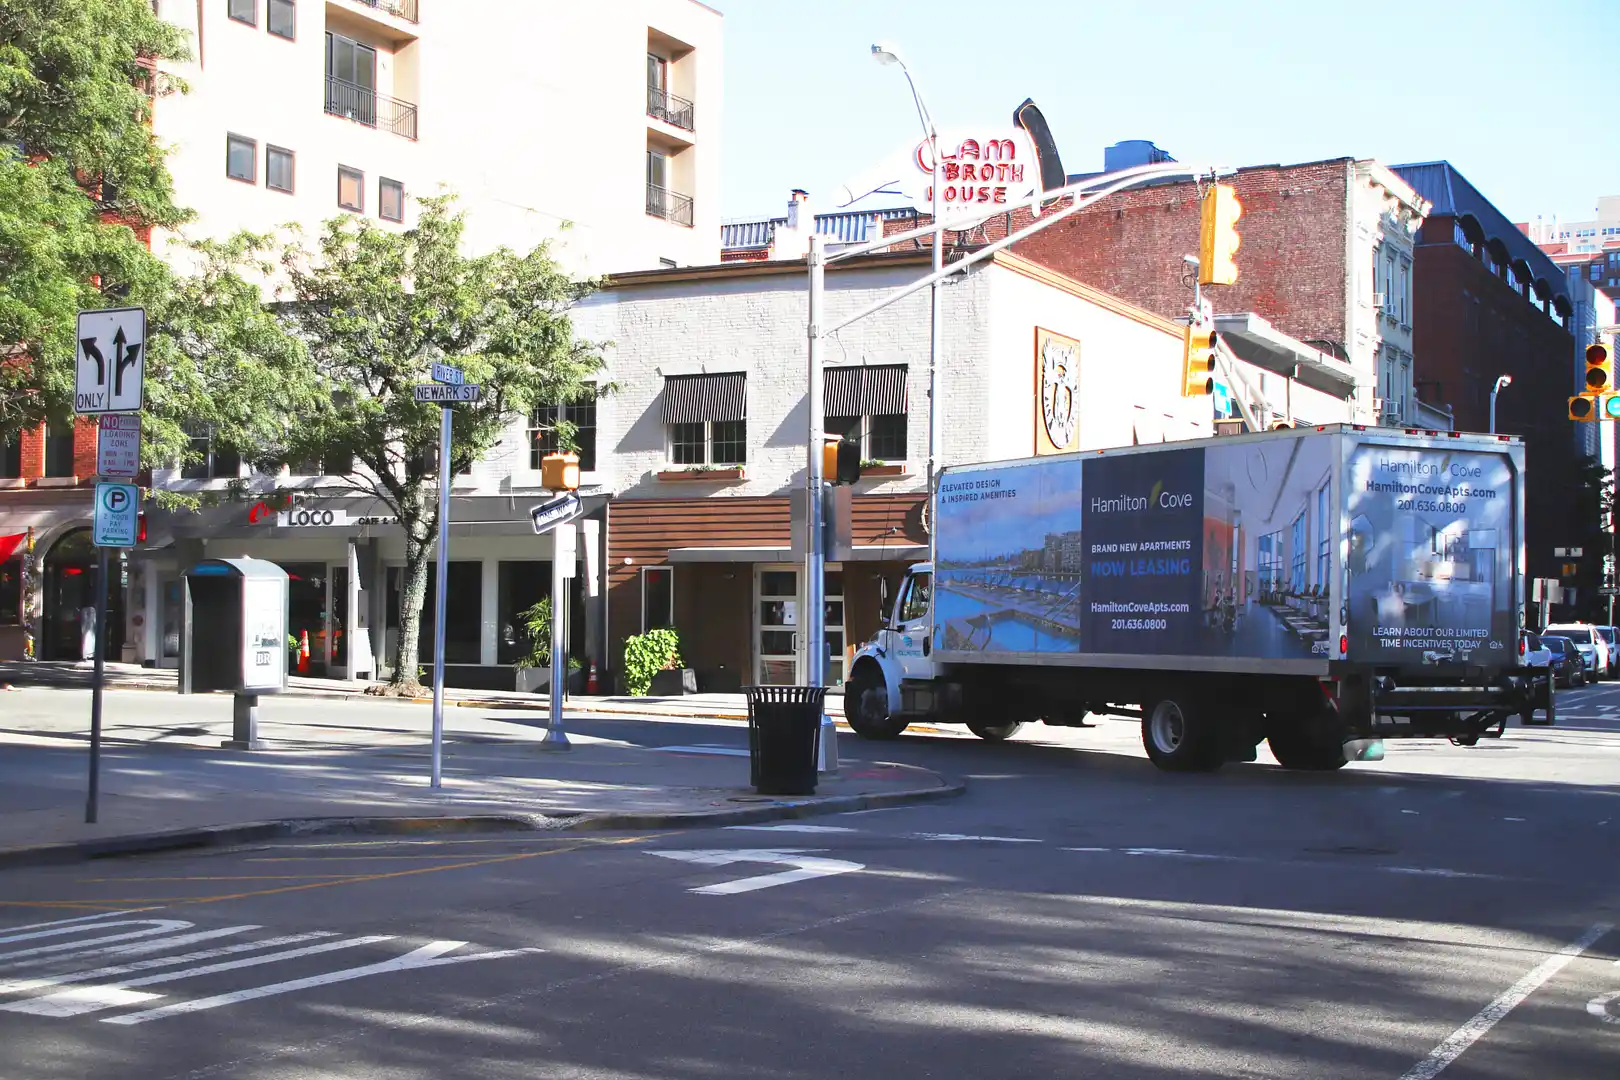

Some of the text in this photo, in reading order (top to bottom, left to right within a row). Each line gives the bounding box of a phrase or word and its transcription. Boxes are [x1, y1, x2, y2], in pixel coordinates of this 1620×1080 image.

[945, 163, 1024, 182] BROTH
[437, 365, 463, 383] RIVER ST
[417, 386, 477, 400] NEWARK ST
[77, 392, 105, 409] ONLY
[103, 416, 118, 428] NO
[104, 431, 136, 440] LOADING
[111, 440, 128, 448] ZONE
[1381, 458, 1482, 478] Hamilton Cove
[941, 480, 1001, 492] ELEVATED DESIGN
[1366, 480, 1496, 499] HamiltonCoveApts.com
[111, 491, 126, 508] P
[941, 489, 1017, 504] & INSPIRED AMENITIES
[1091, 491, 1193, 513] Hamilton Cove
[1397, 500, 1466, 514] 201.636.0800
[288, 510, 334, 526] LOCO
[1091, 540, 1191, 554] BRAND NEW APARTMENTS
[1091, 558, 1191, 577] NOW LEASING
[1091, 601, 1189, 614] HamiltonCoveApts.com
[1111, 619, 1167, 630] 201.636.0800
[1372, 627, 1489, 638] LEARN ABOUT OUR LIMITED
[1380, 639, 1482, 649] TIME INCENTIVES TODAY
